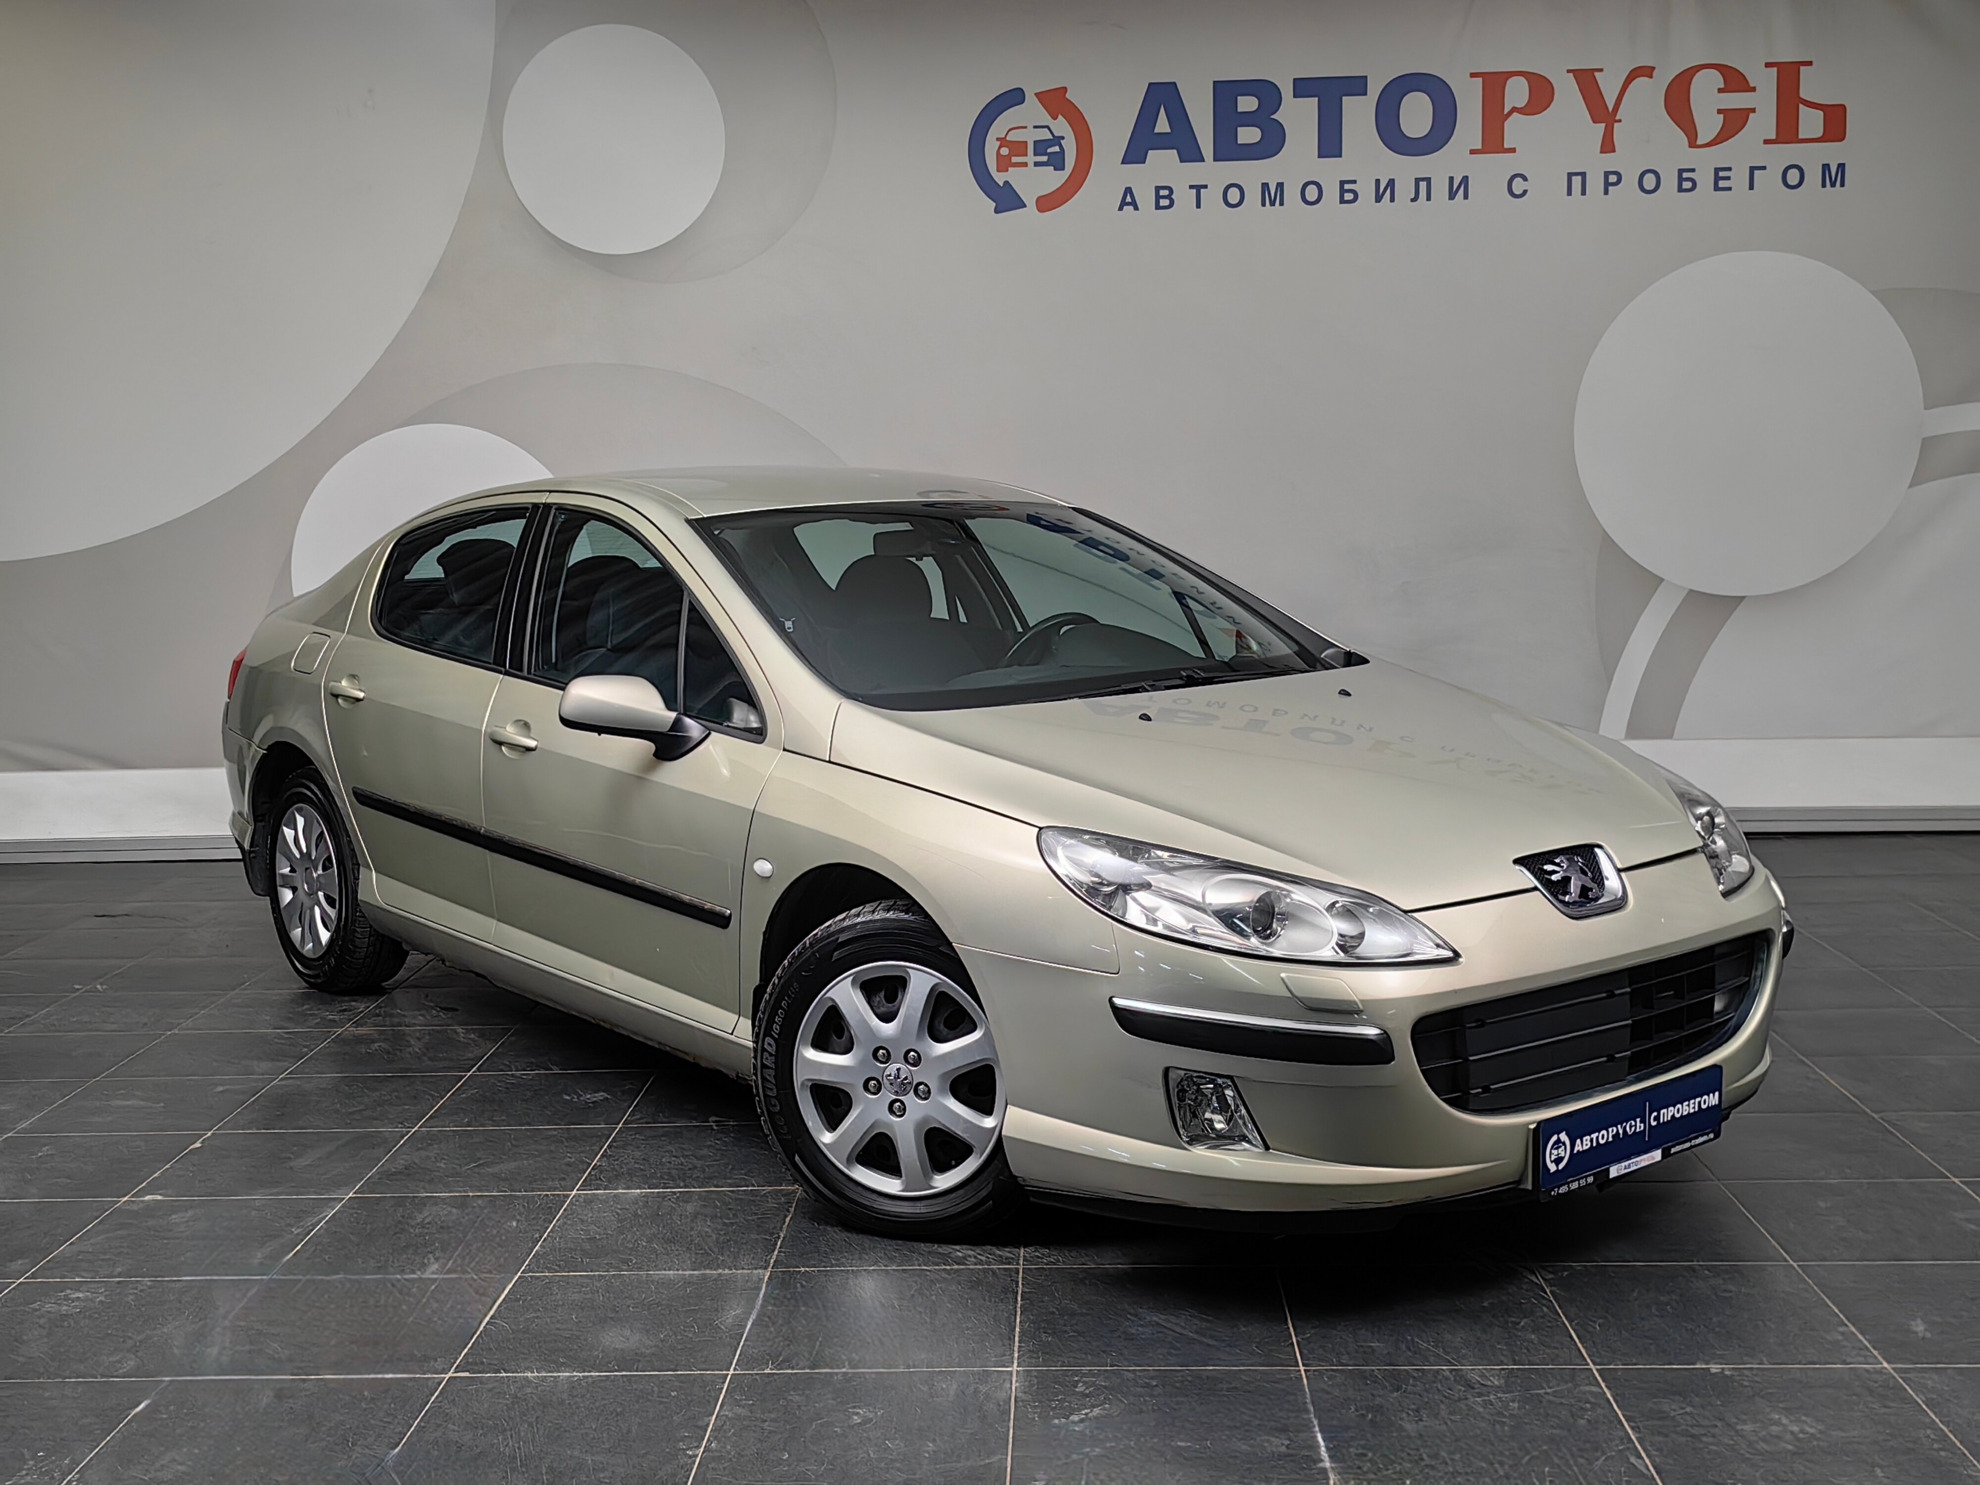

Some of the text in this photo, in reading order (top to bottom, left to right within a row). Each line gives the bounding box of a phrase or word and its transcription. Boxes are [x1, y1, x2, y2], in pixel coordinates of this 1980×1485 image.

[1119, 60, 1848, 166] АВТОРУСЬ
[1117, 162, 1847, 212] АВТОМОБИЛИ С ПРОБЕГОМ
[1650, 1091, 1719, 1127] С ПРОБЕГОМ
[1573, 1117, 1644, 1153] АВТОРУСЬ
